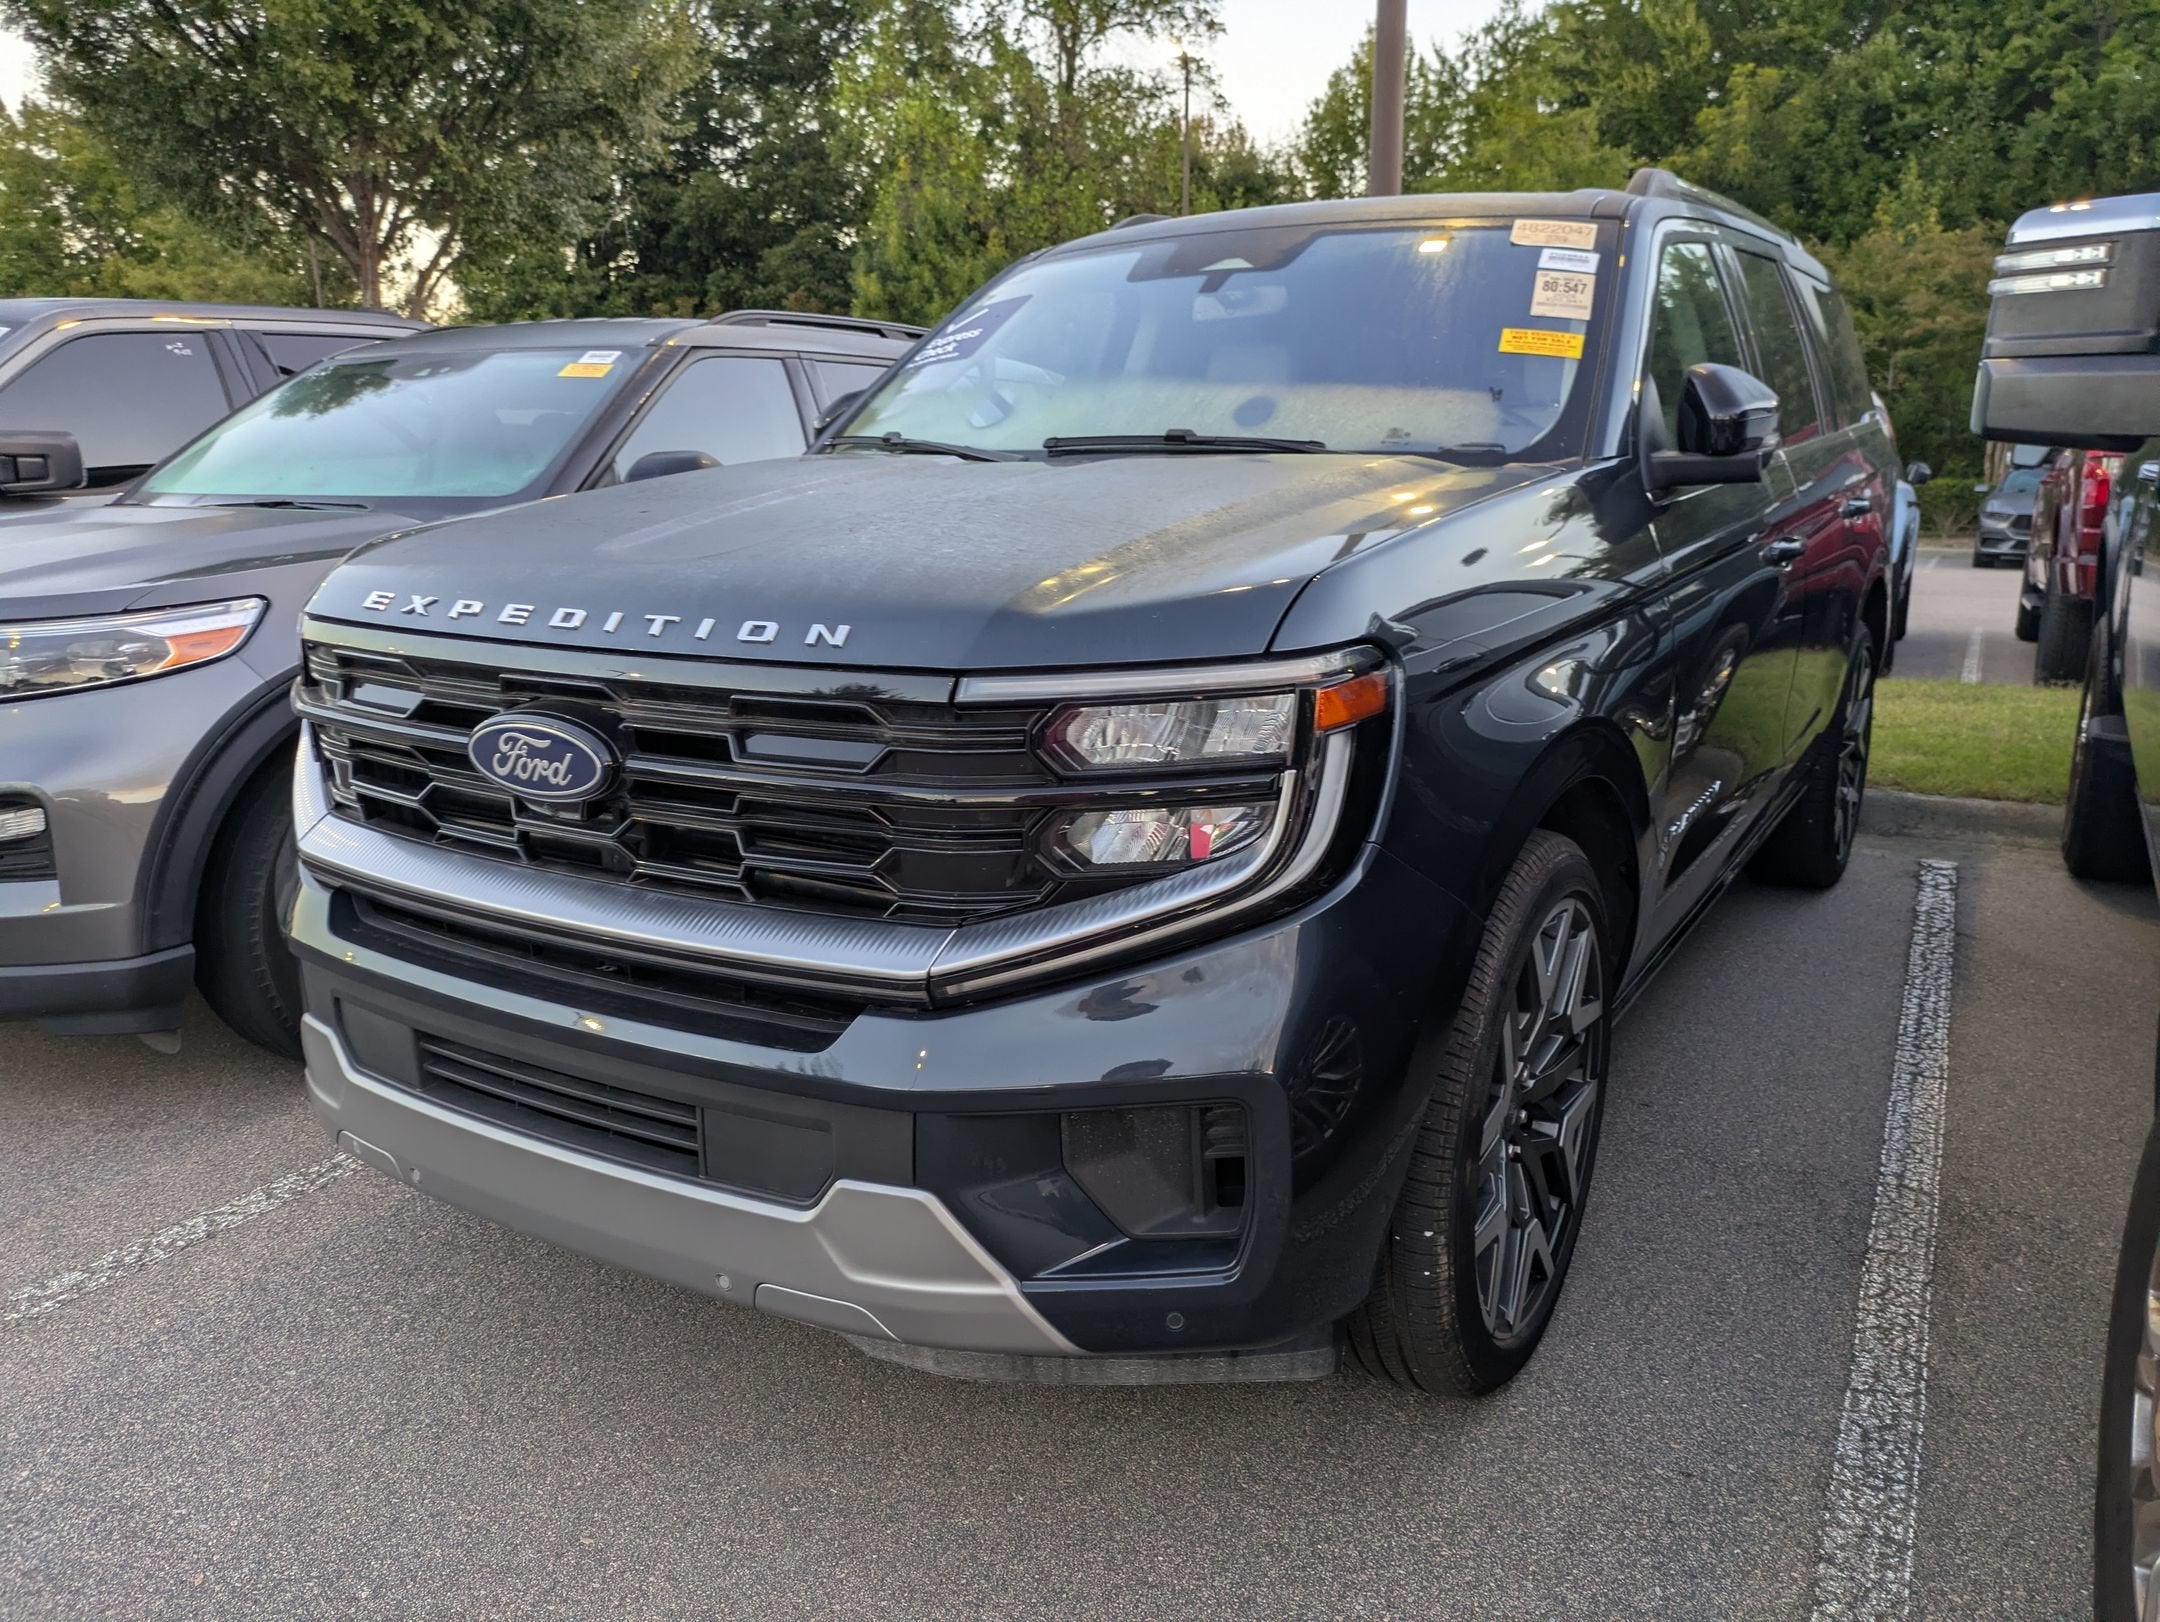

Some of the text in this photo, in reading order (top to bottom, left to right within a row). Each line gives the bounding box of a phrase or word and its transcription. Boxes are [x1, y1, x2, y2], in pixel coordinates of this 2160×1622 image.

[1542, 280, 1588, 295] 80:547
[362, 589, 853, 649] EXPEDITION
[491, 730, 574, 787] Ford
